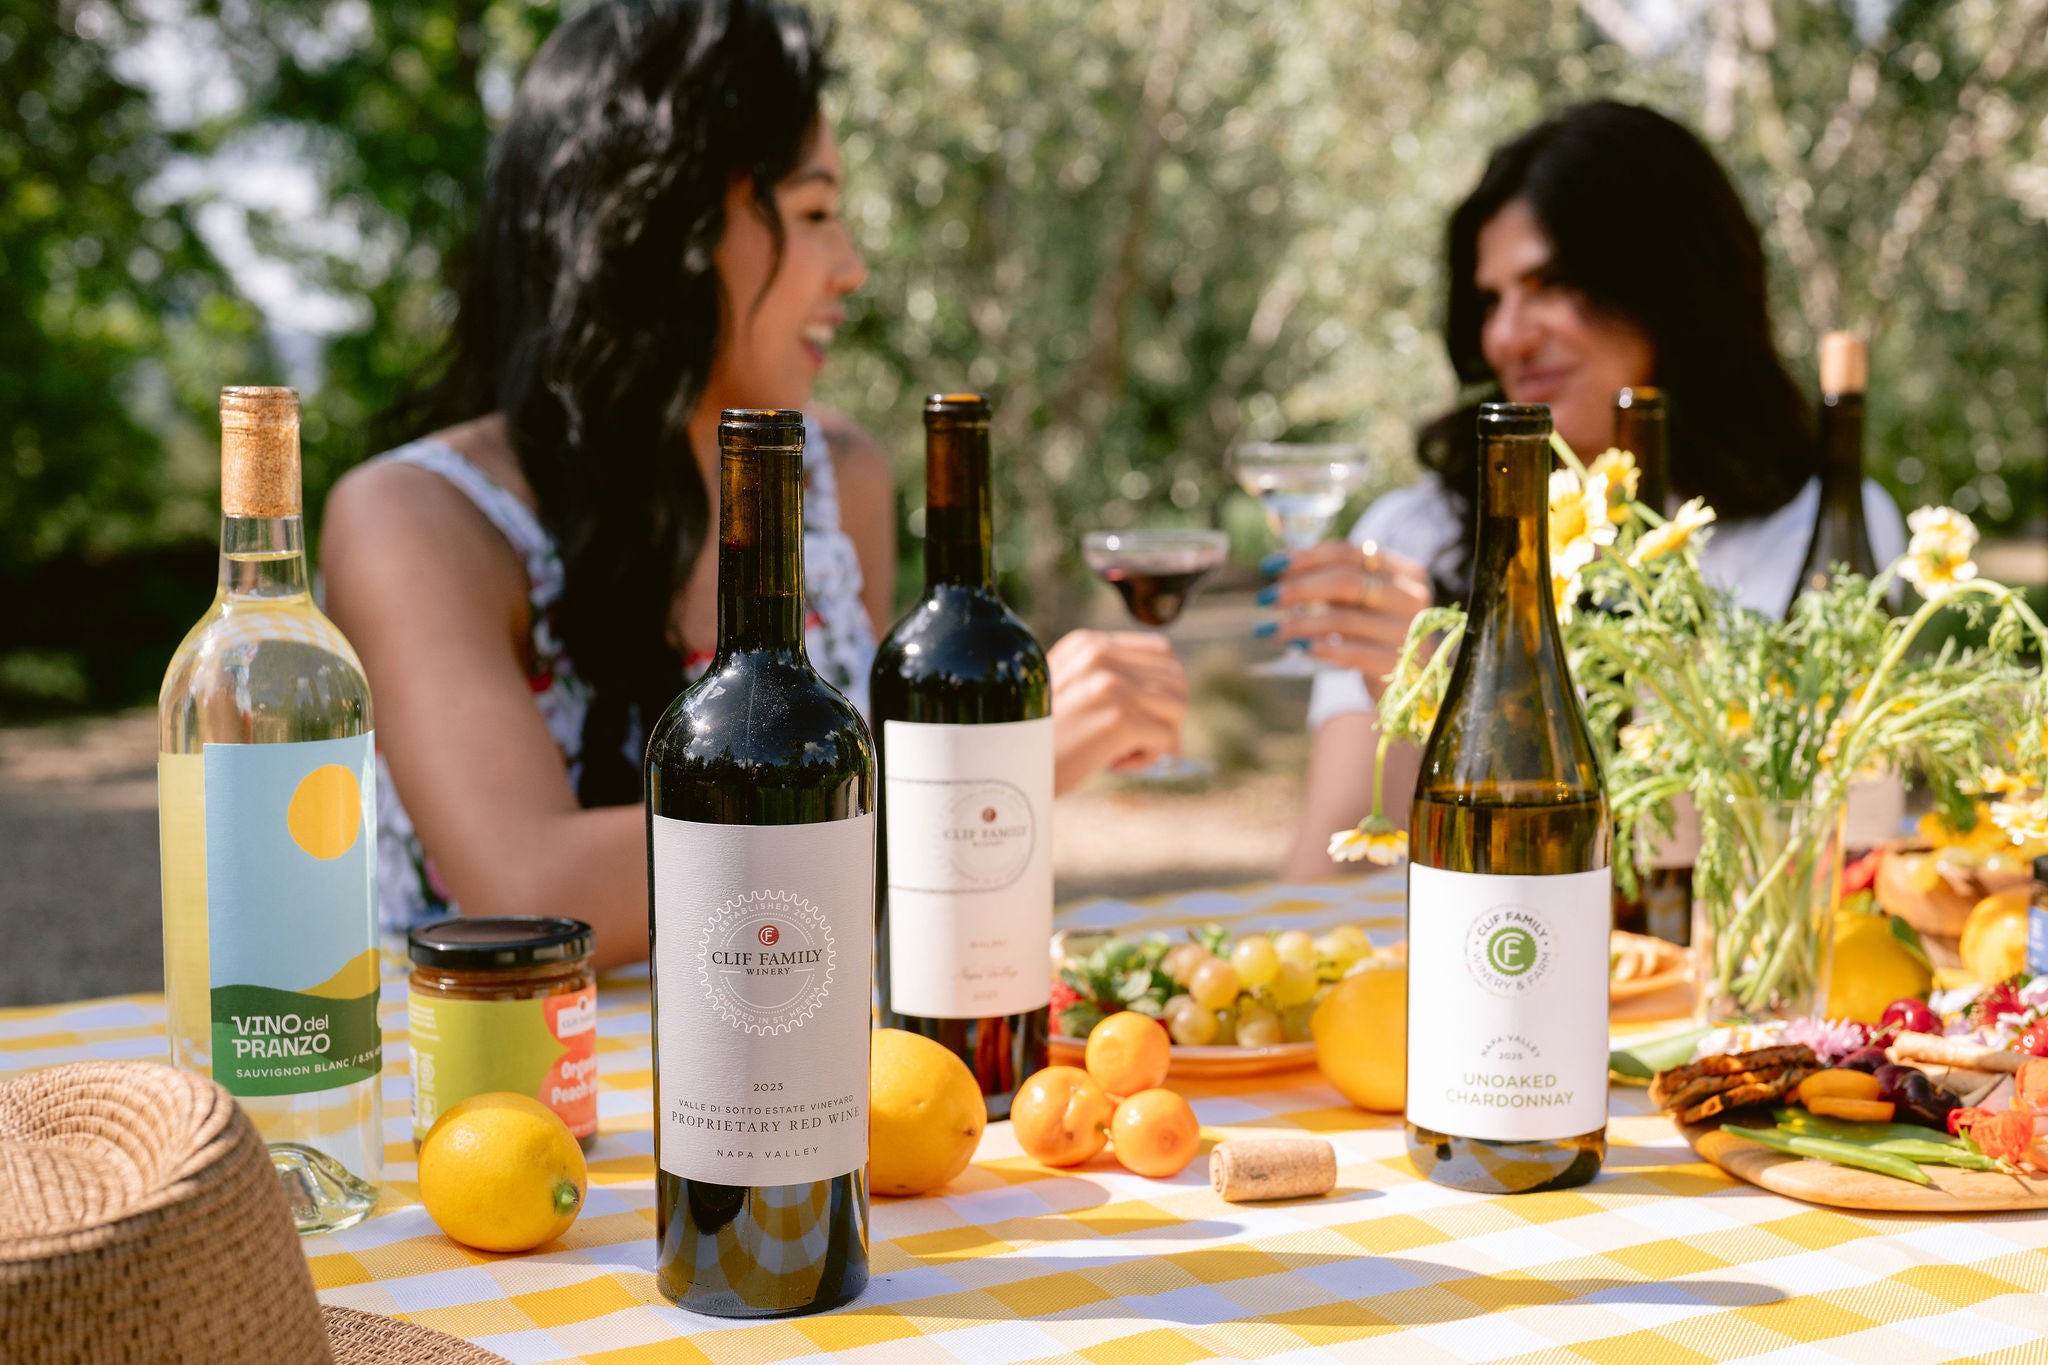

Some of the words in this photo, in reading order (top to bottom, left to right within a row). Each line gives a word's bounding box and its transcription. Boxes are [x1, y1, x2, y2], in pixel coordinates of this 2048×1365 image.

[718, 902, 790, 932] ESTABLISHED
[793, 907, 816, 930] 2004
[1477, 914, 1501, 937] CLIF
[1505, 912, 1548, 937] FAMILY
[711, 951, 753, 966] CLIF
[759, 948, 823, 966] FAMILY
[745, 967, 791, 977] WINERY
[1472, 951, 1512, 990] WINERY
[1526, 951, 1551, 984] FARM
[715, 986, 756, 1023] FOUNDED
[758, 1016, 770, 1025] IN
[773, 1015, 788, 1025] ST.
[789, 986, 821, 1018] HELENA
[231, 1013, 302, 1036] VINO
[303, 1013, 329, 1033] del
[231, 1033, 331, 1059] PRANZO
[236, 1065, 310, 1078] SAUVIGNON
[314, 1058, 350, 1074] BLANC
[753, 1082, 784, 1092] 2023
[1463, 1072, 1558, 1089] UNOAKED
[678, 1098, 706, 1112] VALLE
[725, 1106, 762, 1115] SOTTO
[765, 1104, 806, 1115] ESTATE
[810, 1094, 854, 1111] VINEYARD
[1445, 1089, 1575, 1109] CHARDONNAY
[671, 1110, 782, 1133] PROPRIETARY
[790, 1116, 823, 1131] RED
[828, 1105, 861, 1126] WINE
[716, 1149, 754, 1159] NAPA
[765, 1146, 820, 1159] VALLEY
